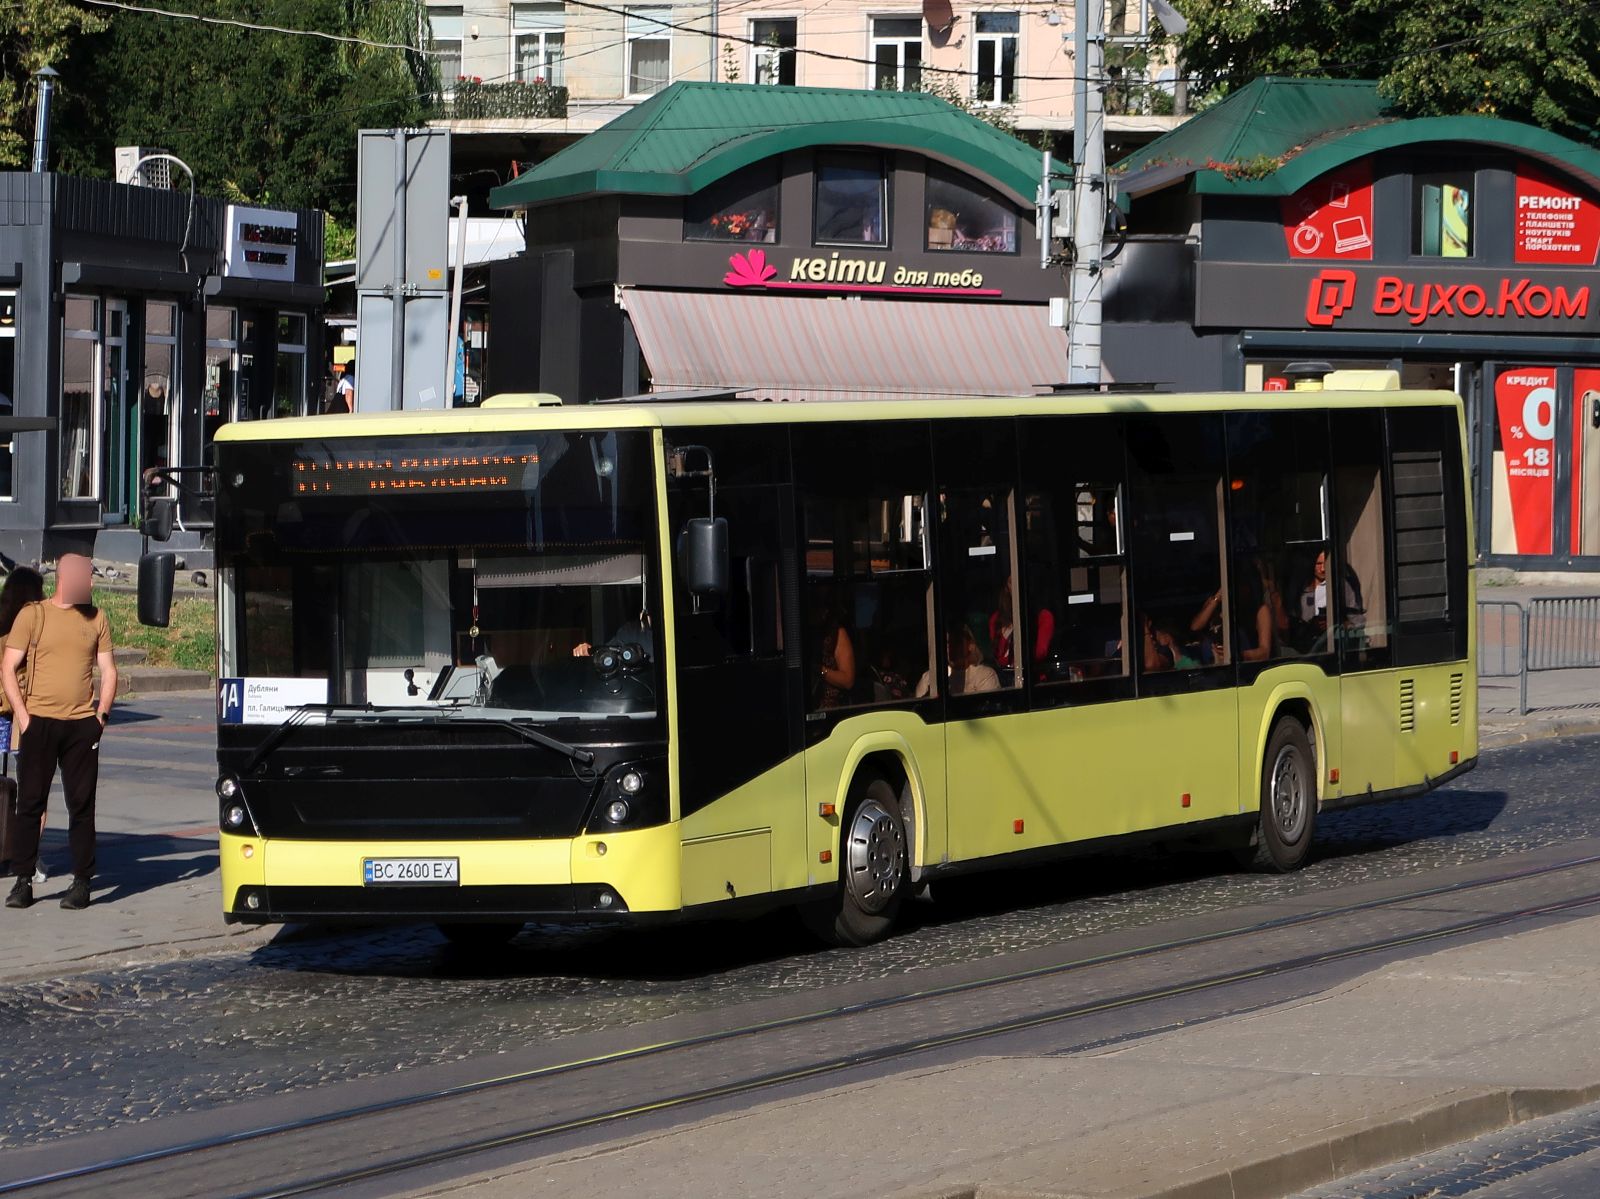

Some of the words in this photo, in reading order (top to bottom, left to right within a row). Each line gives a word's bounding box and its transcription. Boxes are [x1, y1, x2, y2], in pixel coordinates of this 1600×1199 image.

[1518, 196, 1582, 210] РЕМОНТ
[789, 252, 887, 283] квіти
[893, 266, 928, 285] для
[932, 268, 984, 288] тебе
[1372, 276, 1591, 325] Вухо.Ком
[1506, 376, 1550, 386] КРЕДИТ
[1510, 426, 1524, 439] %
[1522, 387, 1556, 441] 0
[1523, 448, 1550, 467] 18
[1509, 468, 1550, 477] МІСЯЦІВ
[247, 684, 279, 694] Дубляни
[374, 863, 394, 878] BC
[398, 863, 430, 878] 2600
[433, 863, 454, 878] EX
